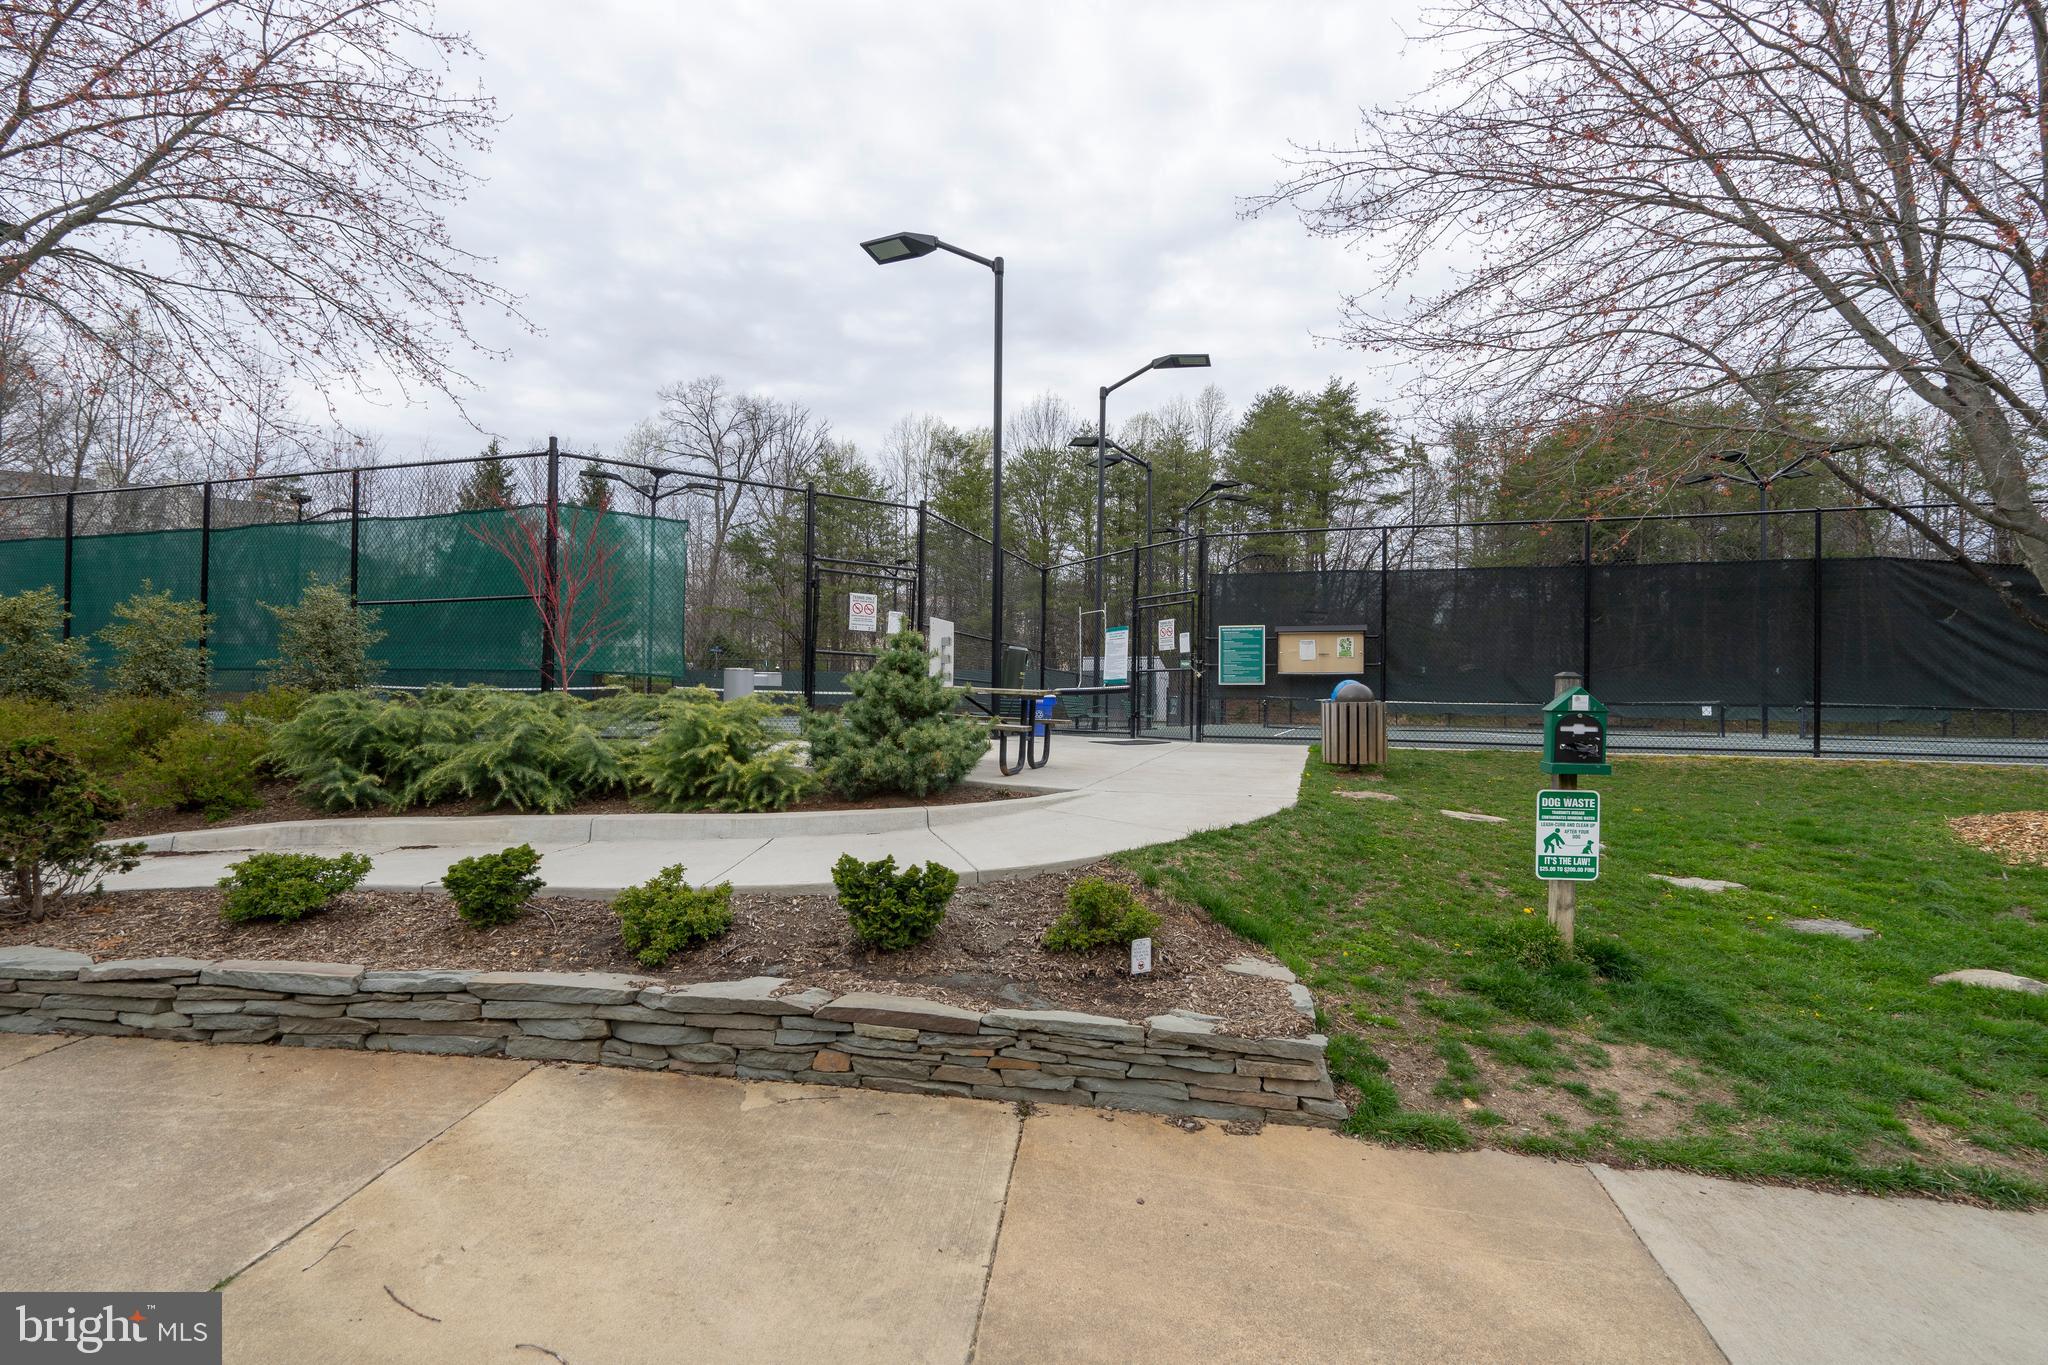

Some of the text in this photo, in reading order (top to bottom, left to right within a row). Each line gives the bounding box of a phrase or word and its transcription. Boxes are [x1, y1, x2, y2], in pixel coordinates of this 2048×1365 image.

[1541, 797, 1596, 808] DOG WASTE
[1544, 856, 1591, 866] IT'S THE LAW!
